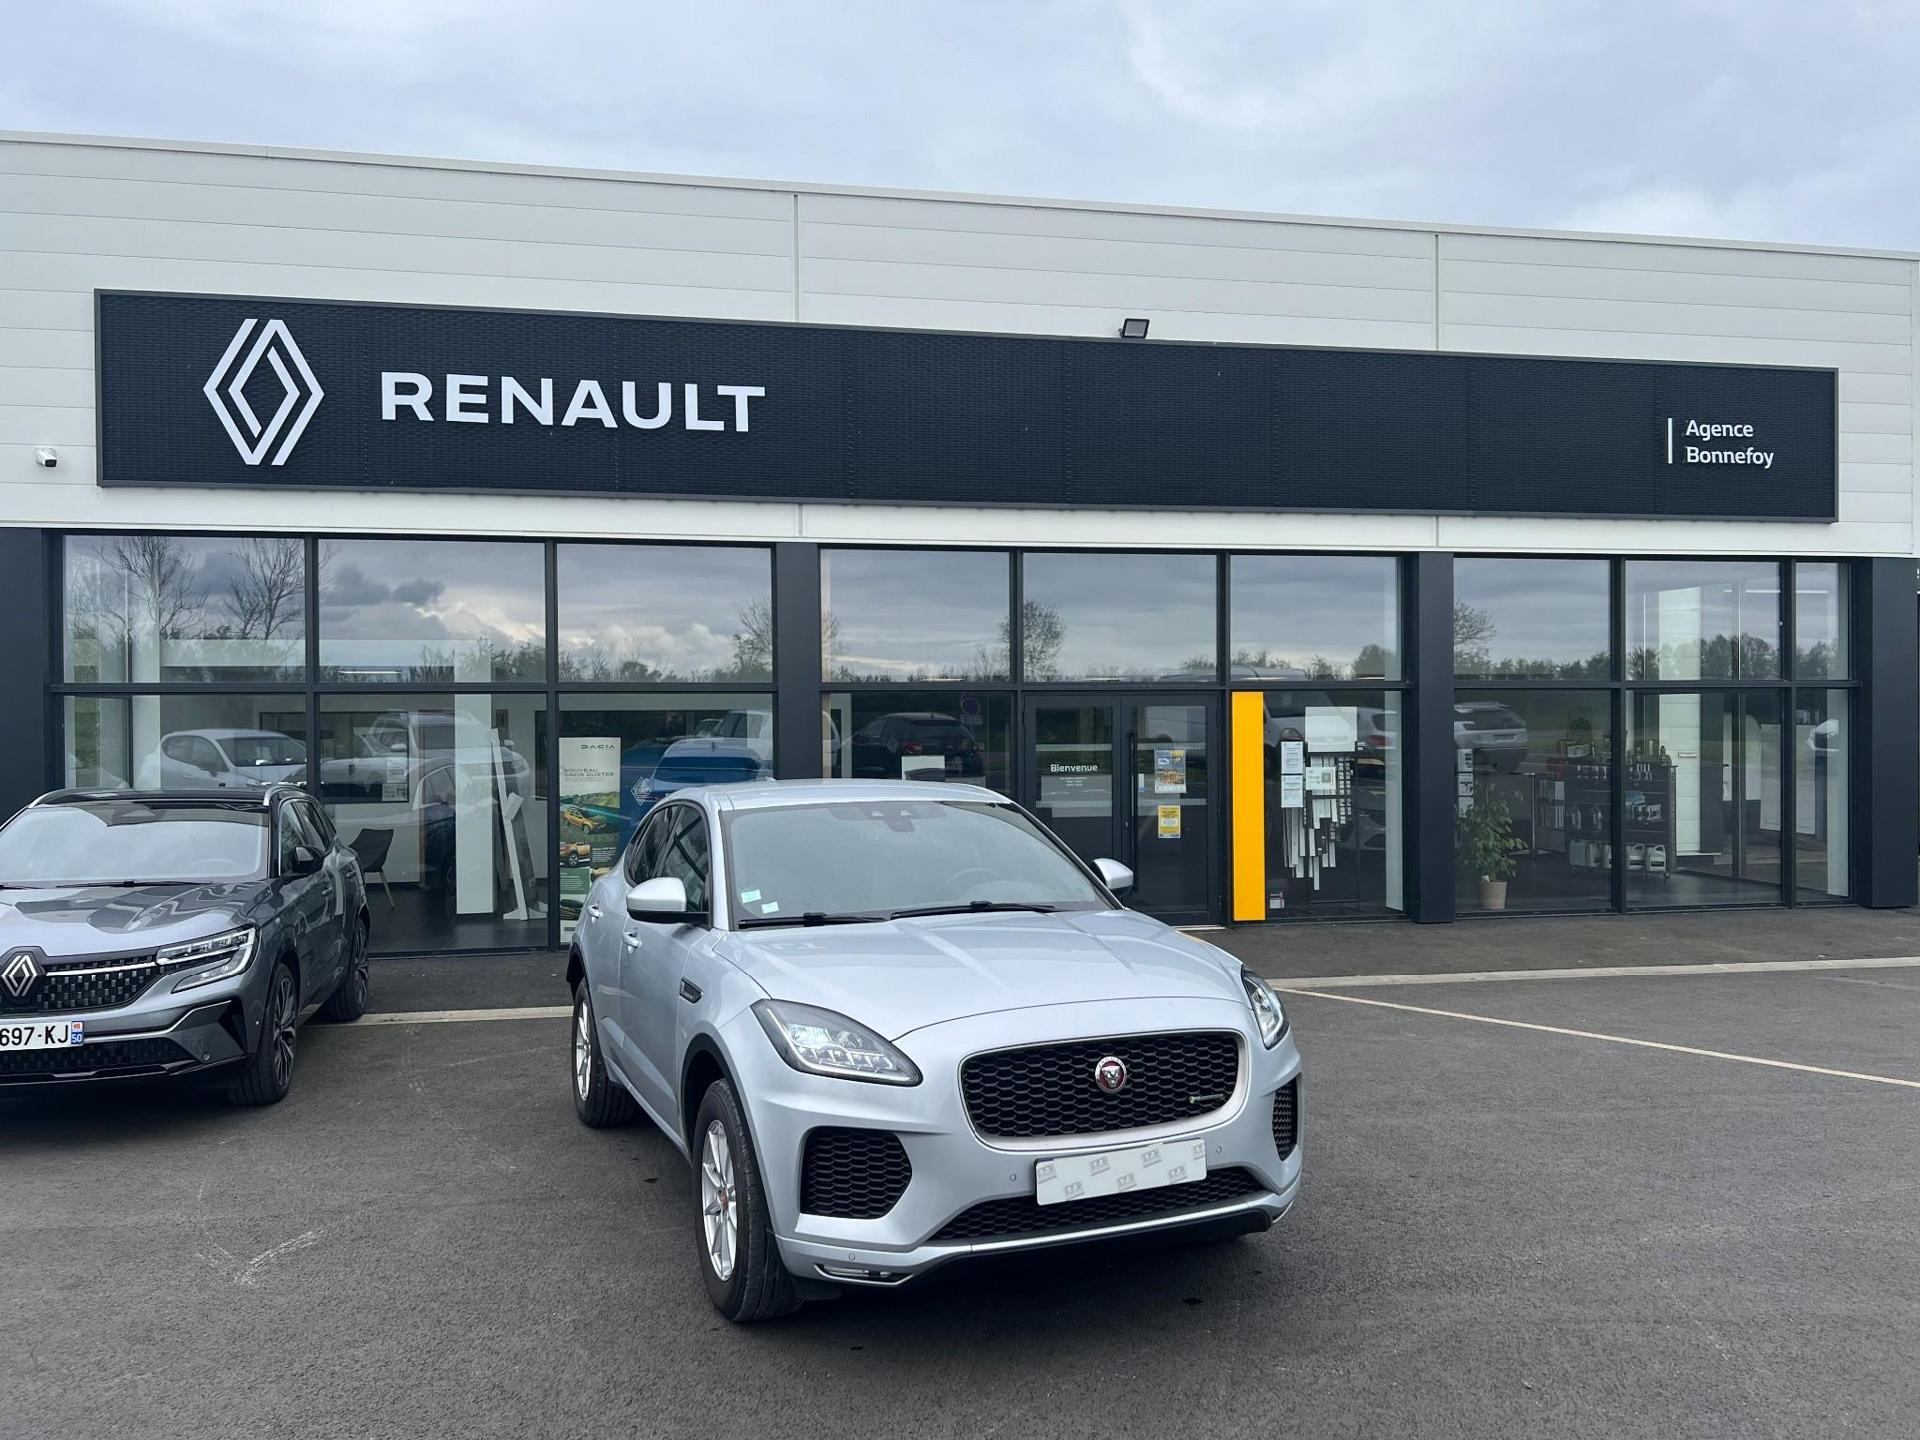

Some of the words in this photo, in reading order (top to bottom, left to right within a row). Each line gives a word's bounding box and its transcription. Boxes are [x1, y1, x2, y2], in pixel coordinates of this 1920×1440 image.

[381, 372, 766, 432] RENAULT
[1685, 419, 1754, 441] Agence
[1686, 446, 1774, 469] Bonnefoy
[1050, 763, 1098, 773] Bienvenue
[0, 1024, 69, 1047] 697-KJ
[71, 1033, 82, 1043] 50
